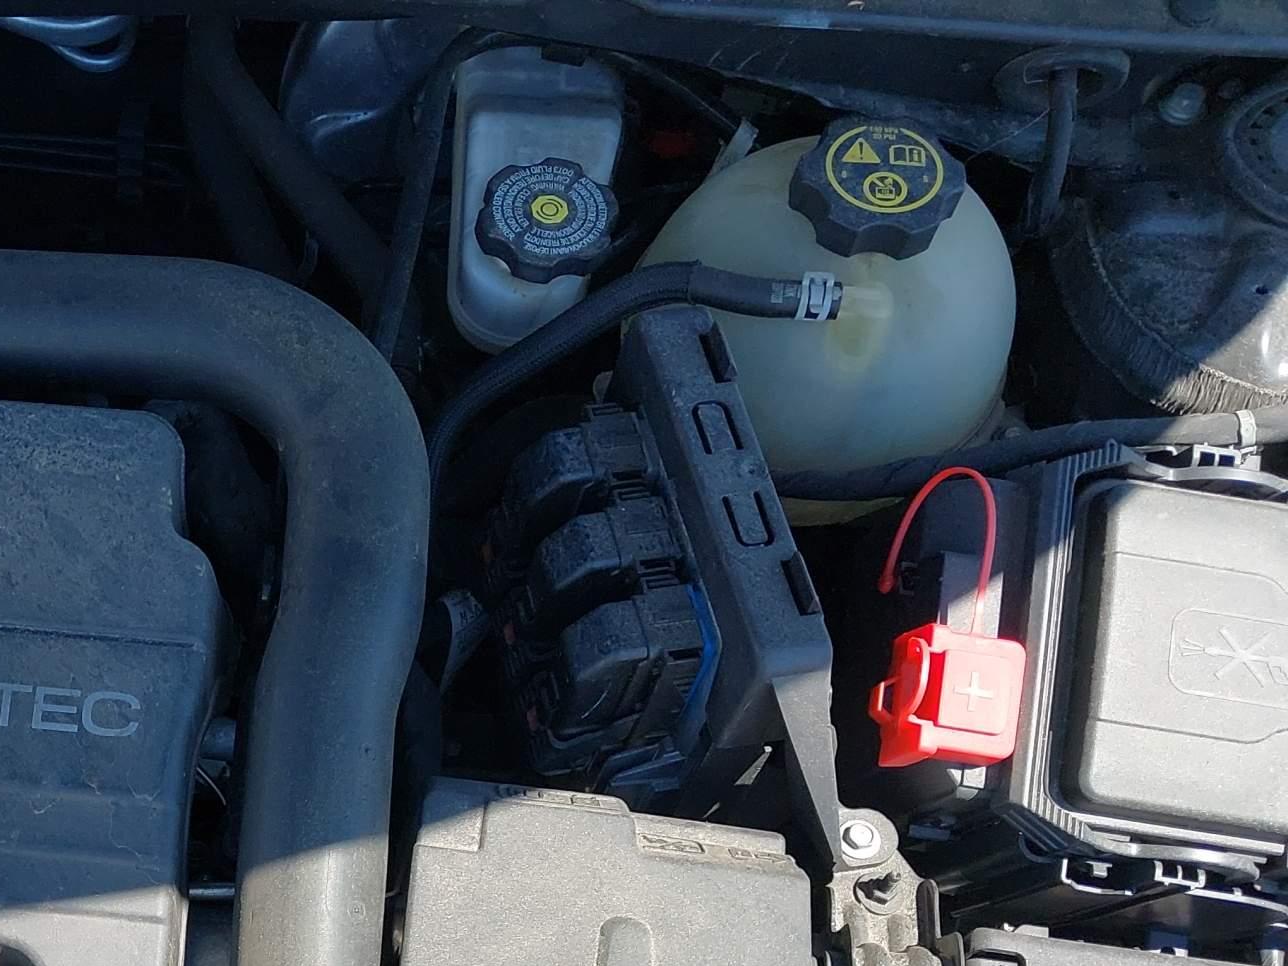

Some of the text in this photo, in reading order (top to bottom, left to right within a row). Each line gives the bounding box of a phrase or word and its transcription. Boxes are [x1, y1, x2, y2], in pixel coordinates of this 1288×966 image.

[508, 168, 531, 183] FROM
[529, 166, 552, 174] FLUID
[492, 182, 511, 205] SEALED
[493, 205, 515, 241] CONTAINER
